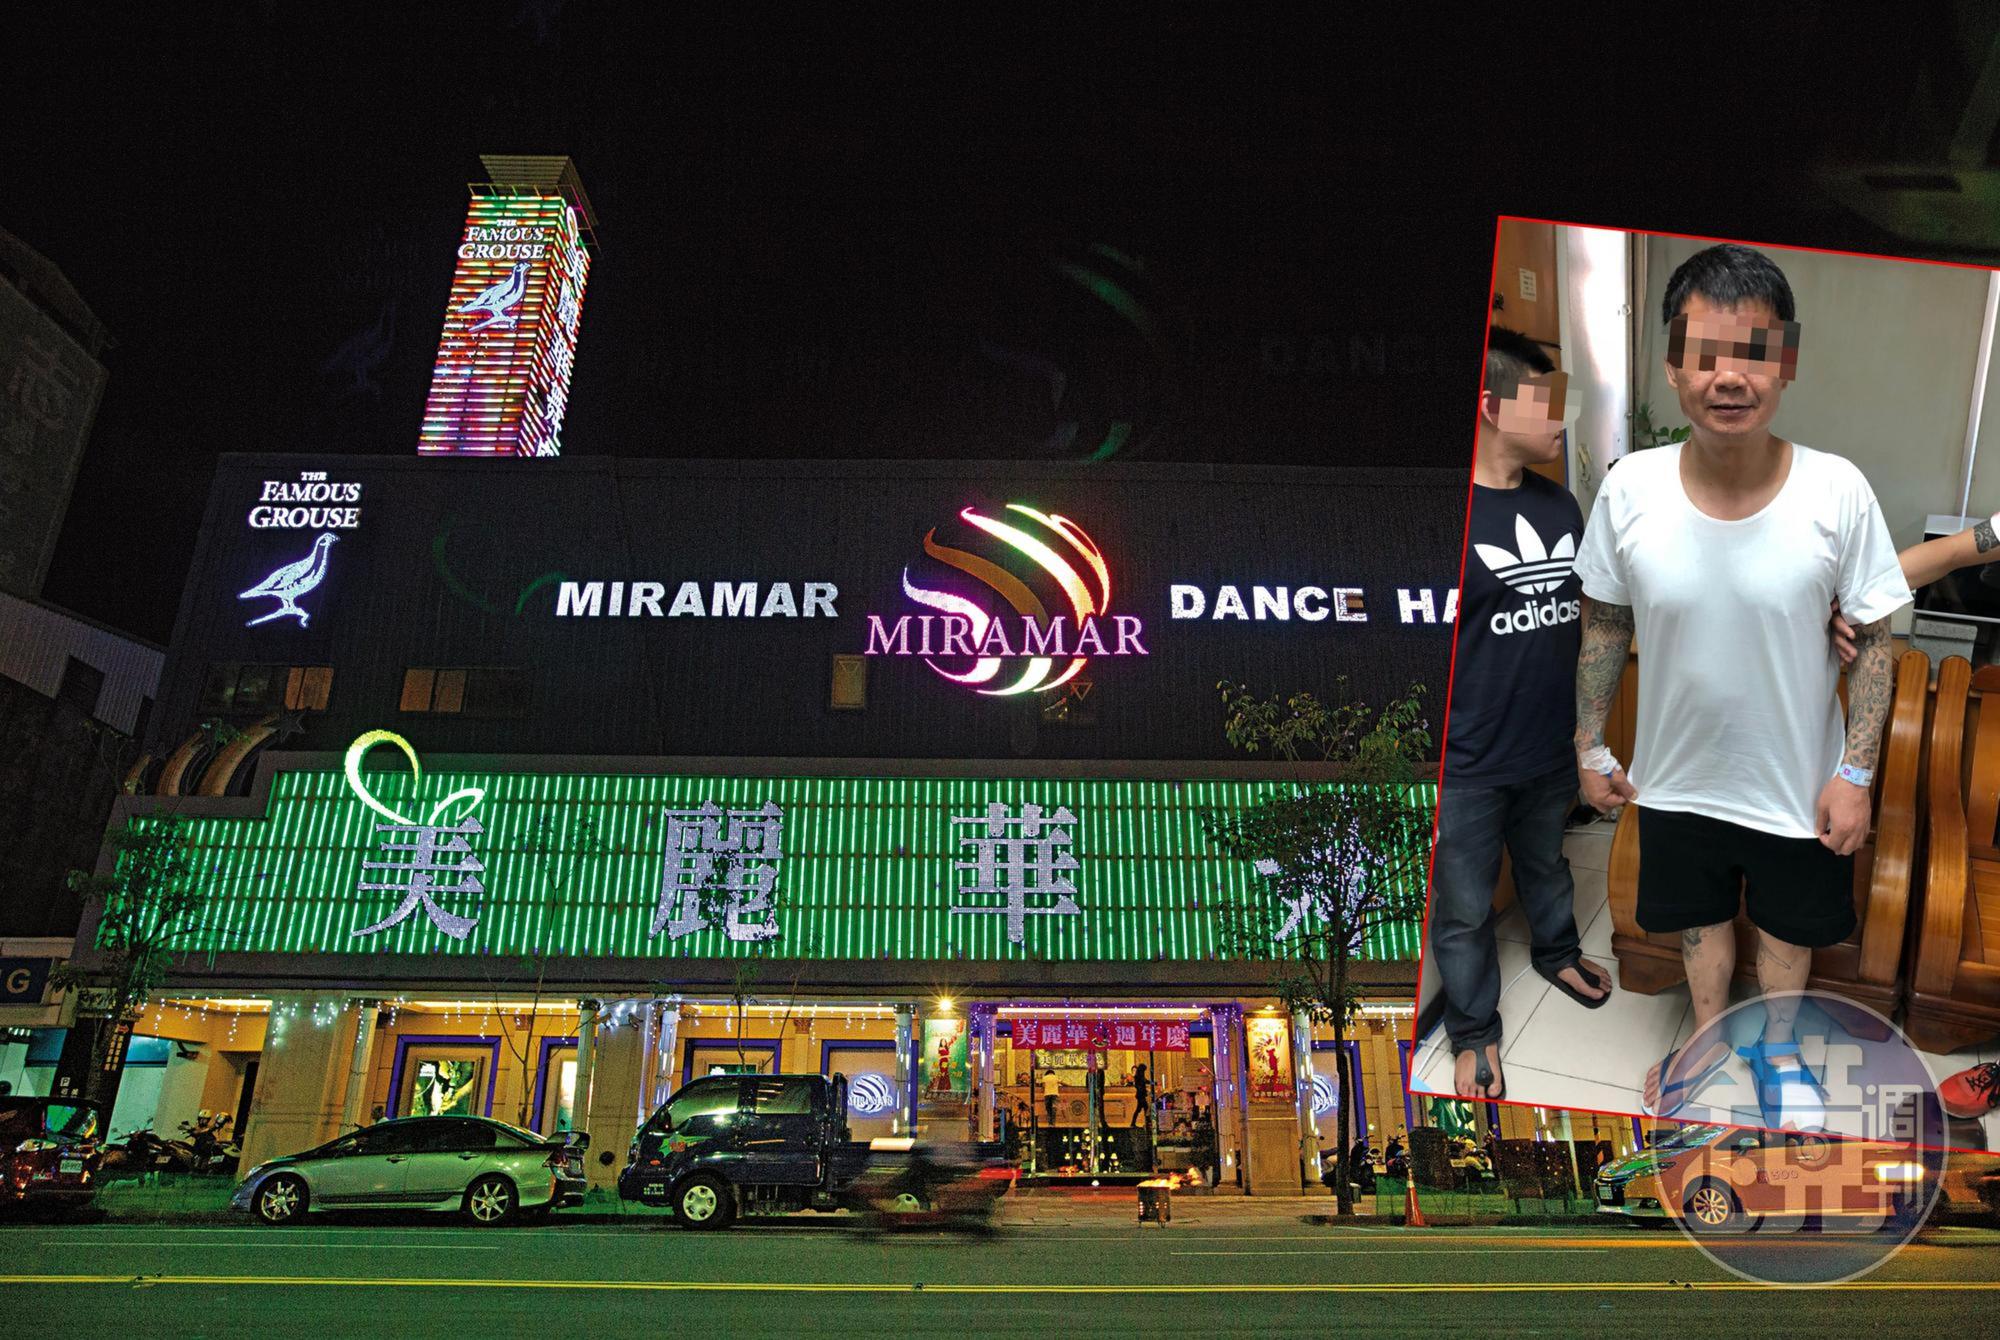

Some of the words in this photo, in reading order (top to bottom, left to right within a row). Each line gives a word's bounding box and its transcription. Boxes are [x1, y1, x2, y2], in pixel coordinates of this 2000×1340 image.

[465, 226, 545, 242] FAMOUS
[496, 219, 518, 227] THE
[457, 243, 545, 260] GROUSE
[301, 471, 327, 481] THE
[259, 481, 361, 502] FAMOUS
[248, 506, 360, 528] GROUSE
[556, 581, 839, 617] MIRAMAR
[1171, 584, 1368, 622] DANCE
[1490, 597, 1581, 635] adidas
[864, 615, 1149, 656] MIRAMAR
[1016, 1023, 1189, 1048] 美麗華週年慶
